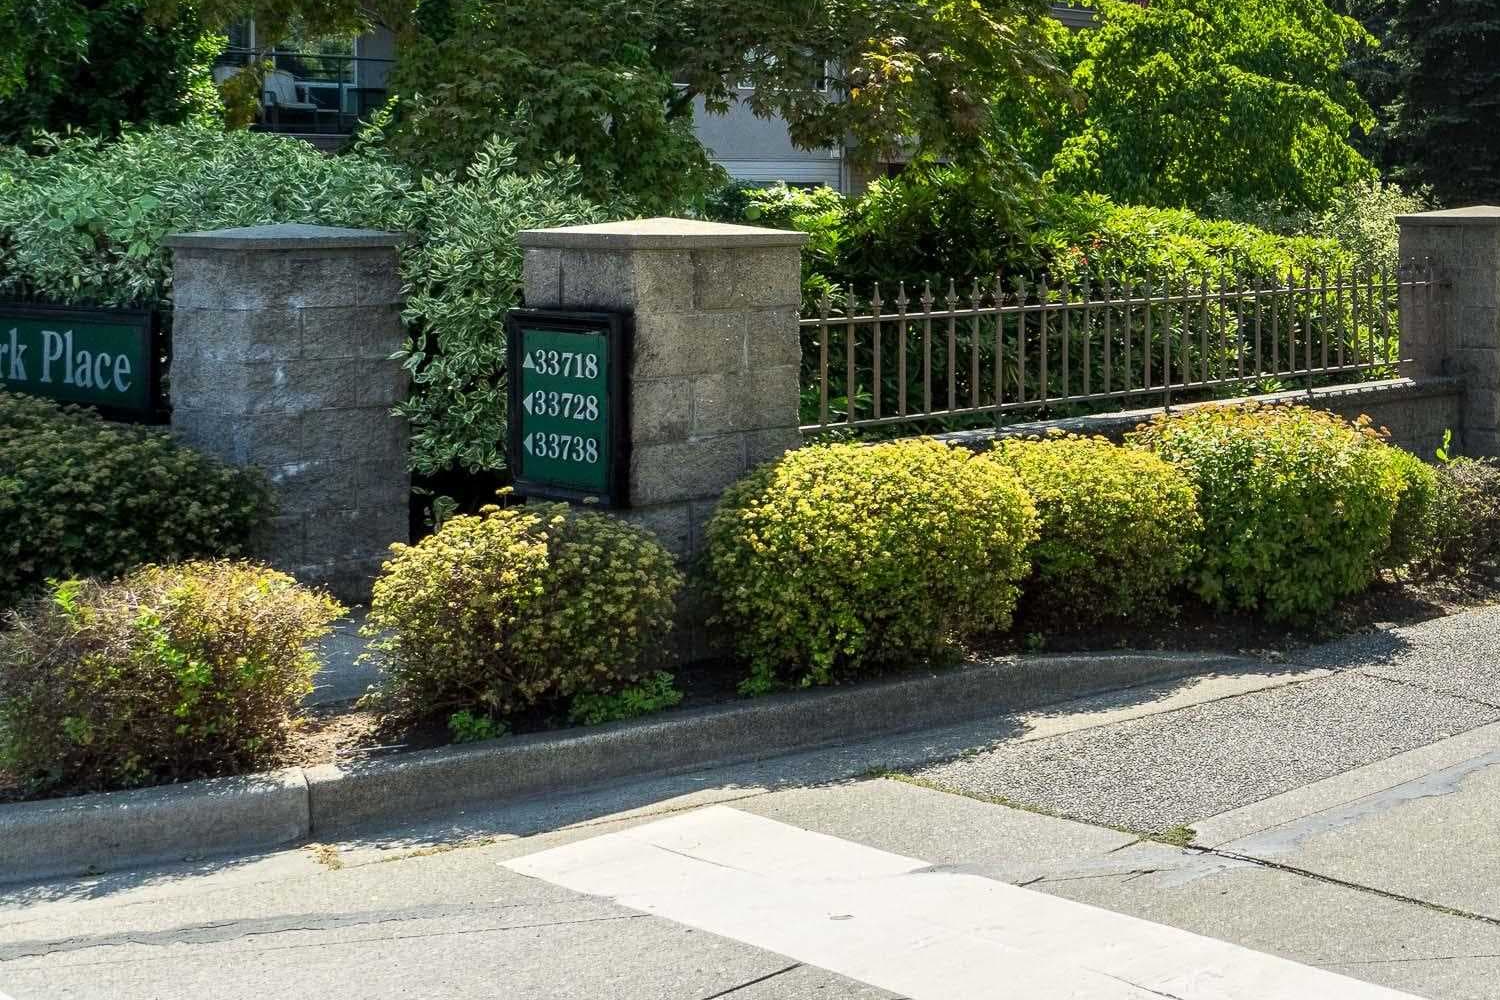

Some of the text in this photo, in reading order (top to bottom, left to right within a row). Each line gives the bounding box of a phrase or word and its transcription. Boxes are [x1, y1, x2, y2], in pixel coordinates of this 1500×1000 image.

[40, 329, 132, 393] Place
[535, 350, 598, 379] 33718
[535, 391, 599, 421] 33728
[535, 432, 598, 464] 33738
